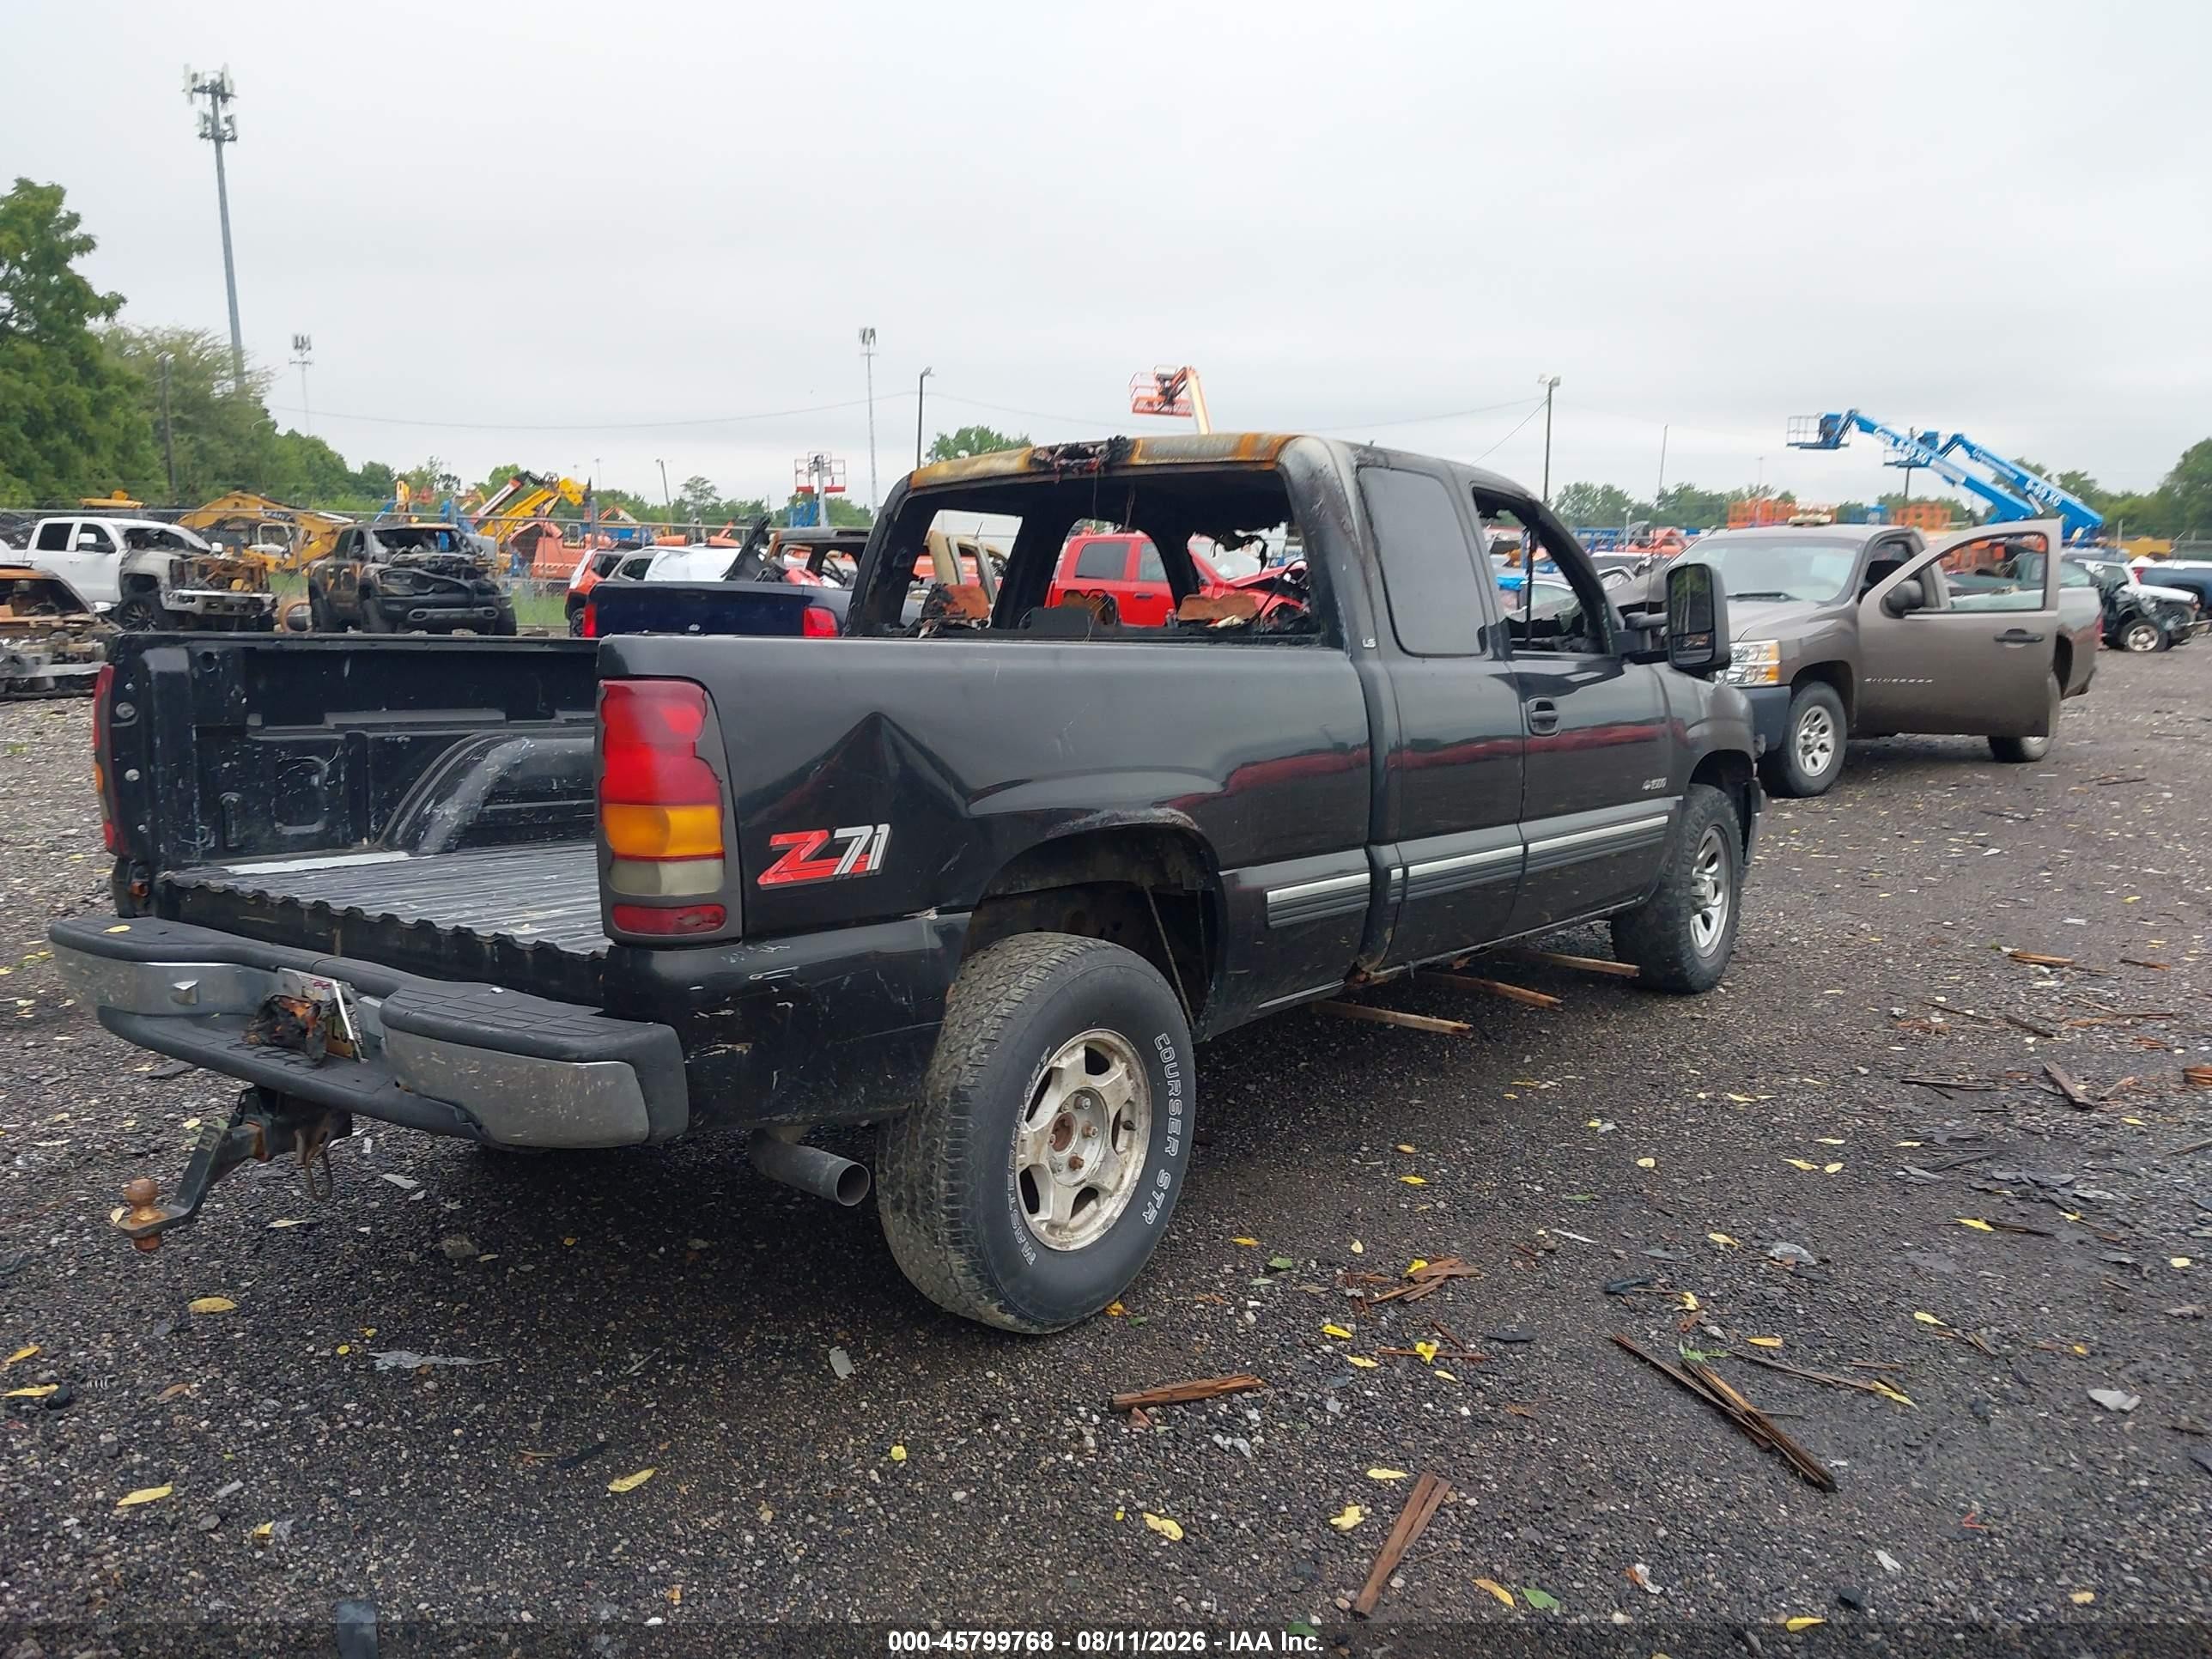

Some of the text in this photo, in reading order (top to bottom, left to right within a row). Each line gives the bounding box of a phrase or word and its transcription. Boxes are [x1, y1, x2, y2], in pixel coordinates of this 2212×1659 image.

[757, 823, 891, 889] Z71
[1142, 1032, 1183, 1224] COURSER STR
